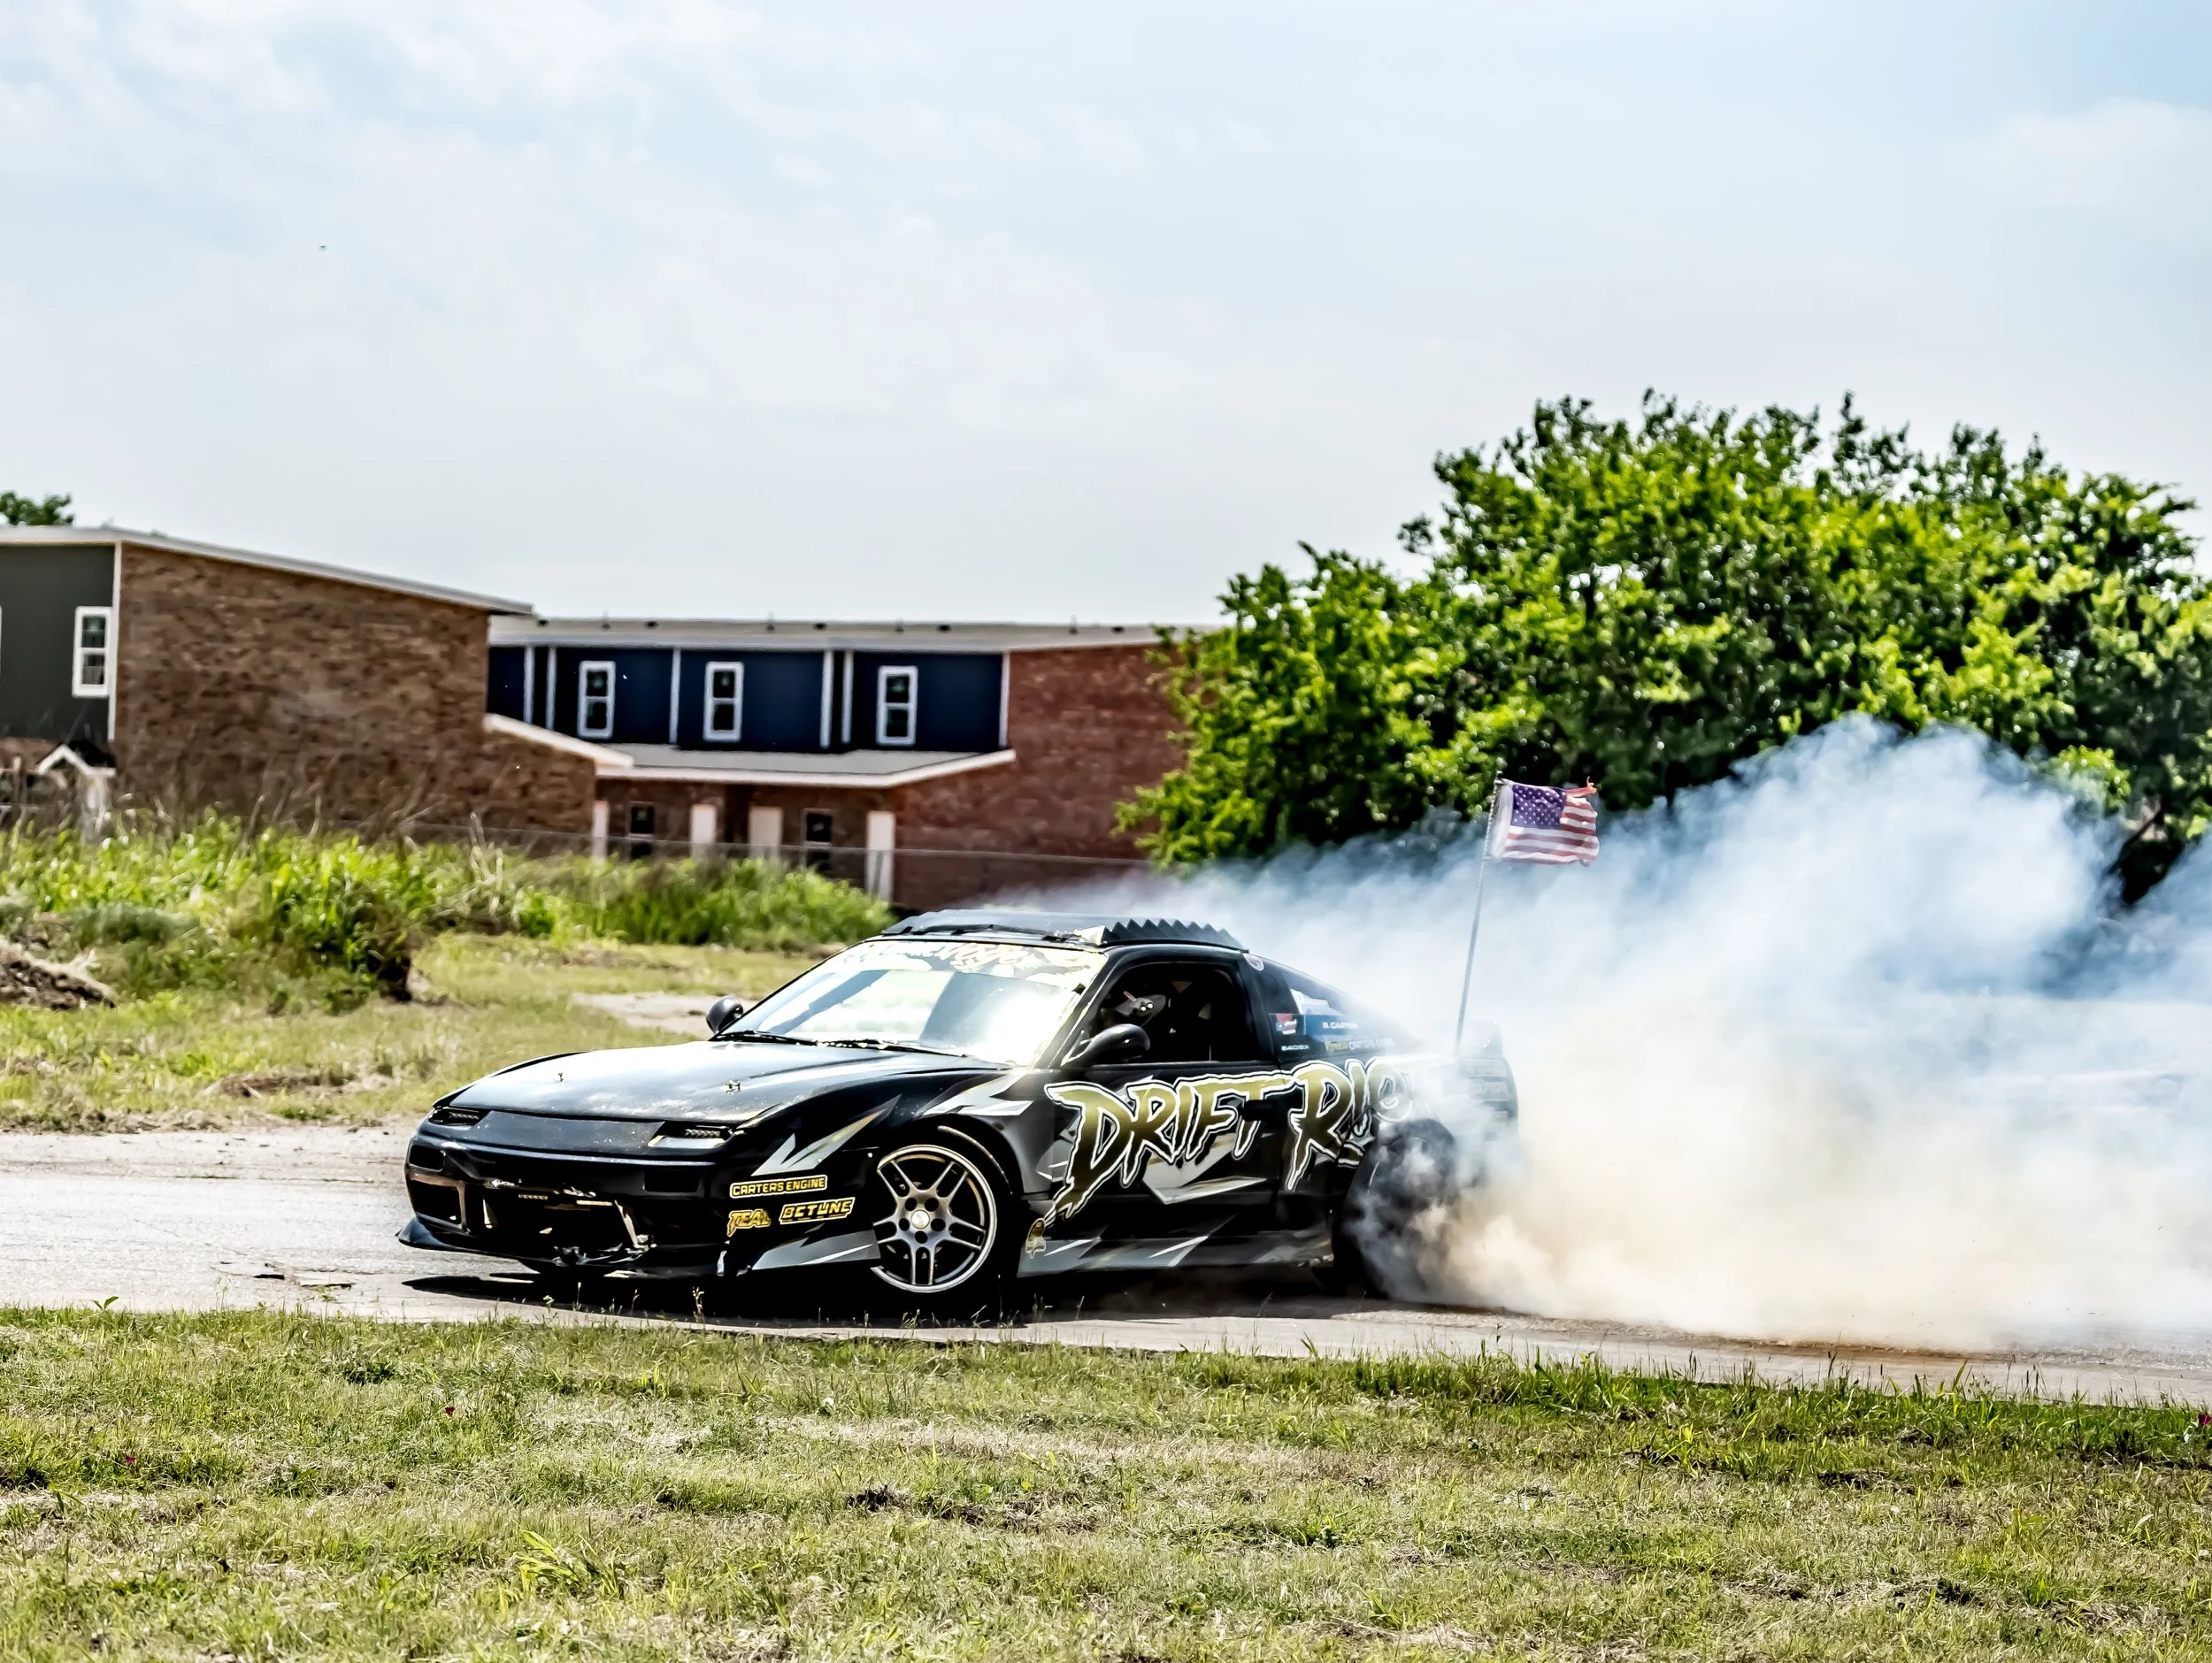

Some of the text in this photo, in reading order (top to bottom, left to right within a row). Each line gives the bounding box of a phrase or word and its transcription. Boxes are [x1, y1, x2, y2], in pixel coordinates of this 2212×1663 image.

[732, 1176, 826, 1197] CARTERS ENGINE
[1044, 1056, 1421, 1224] DRIFT RIO
